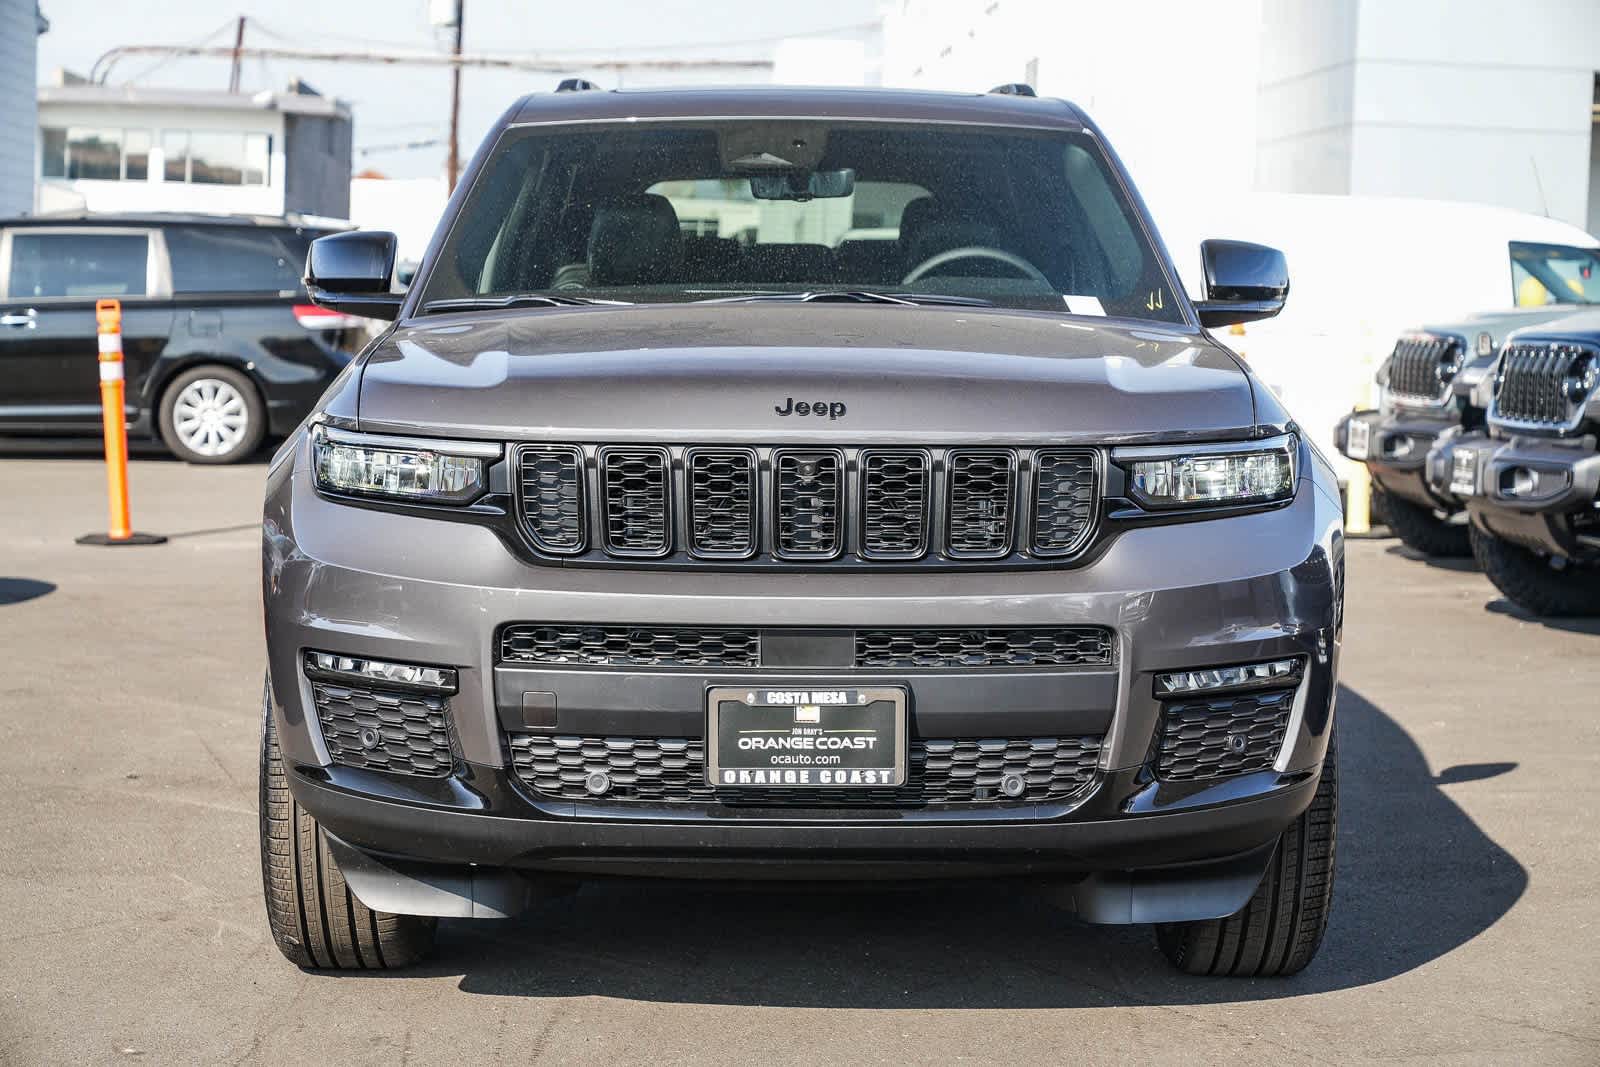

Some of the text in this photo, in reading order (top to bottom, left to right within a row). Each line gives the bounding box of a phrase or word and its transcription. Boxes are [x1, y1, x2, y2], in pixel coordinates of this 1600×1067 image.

[775, 397, 847, 421] Jeep
[766, 691, 848, 704] COSTA MESA
[738, 737, 877, 750] ORANGE COAST
[770, 753, 841, 765] ocauto.com
[724, 770, 890, 784] ORANGE COAST
